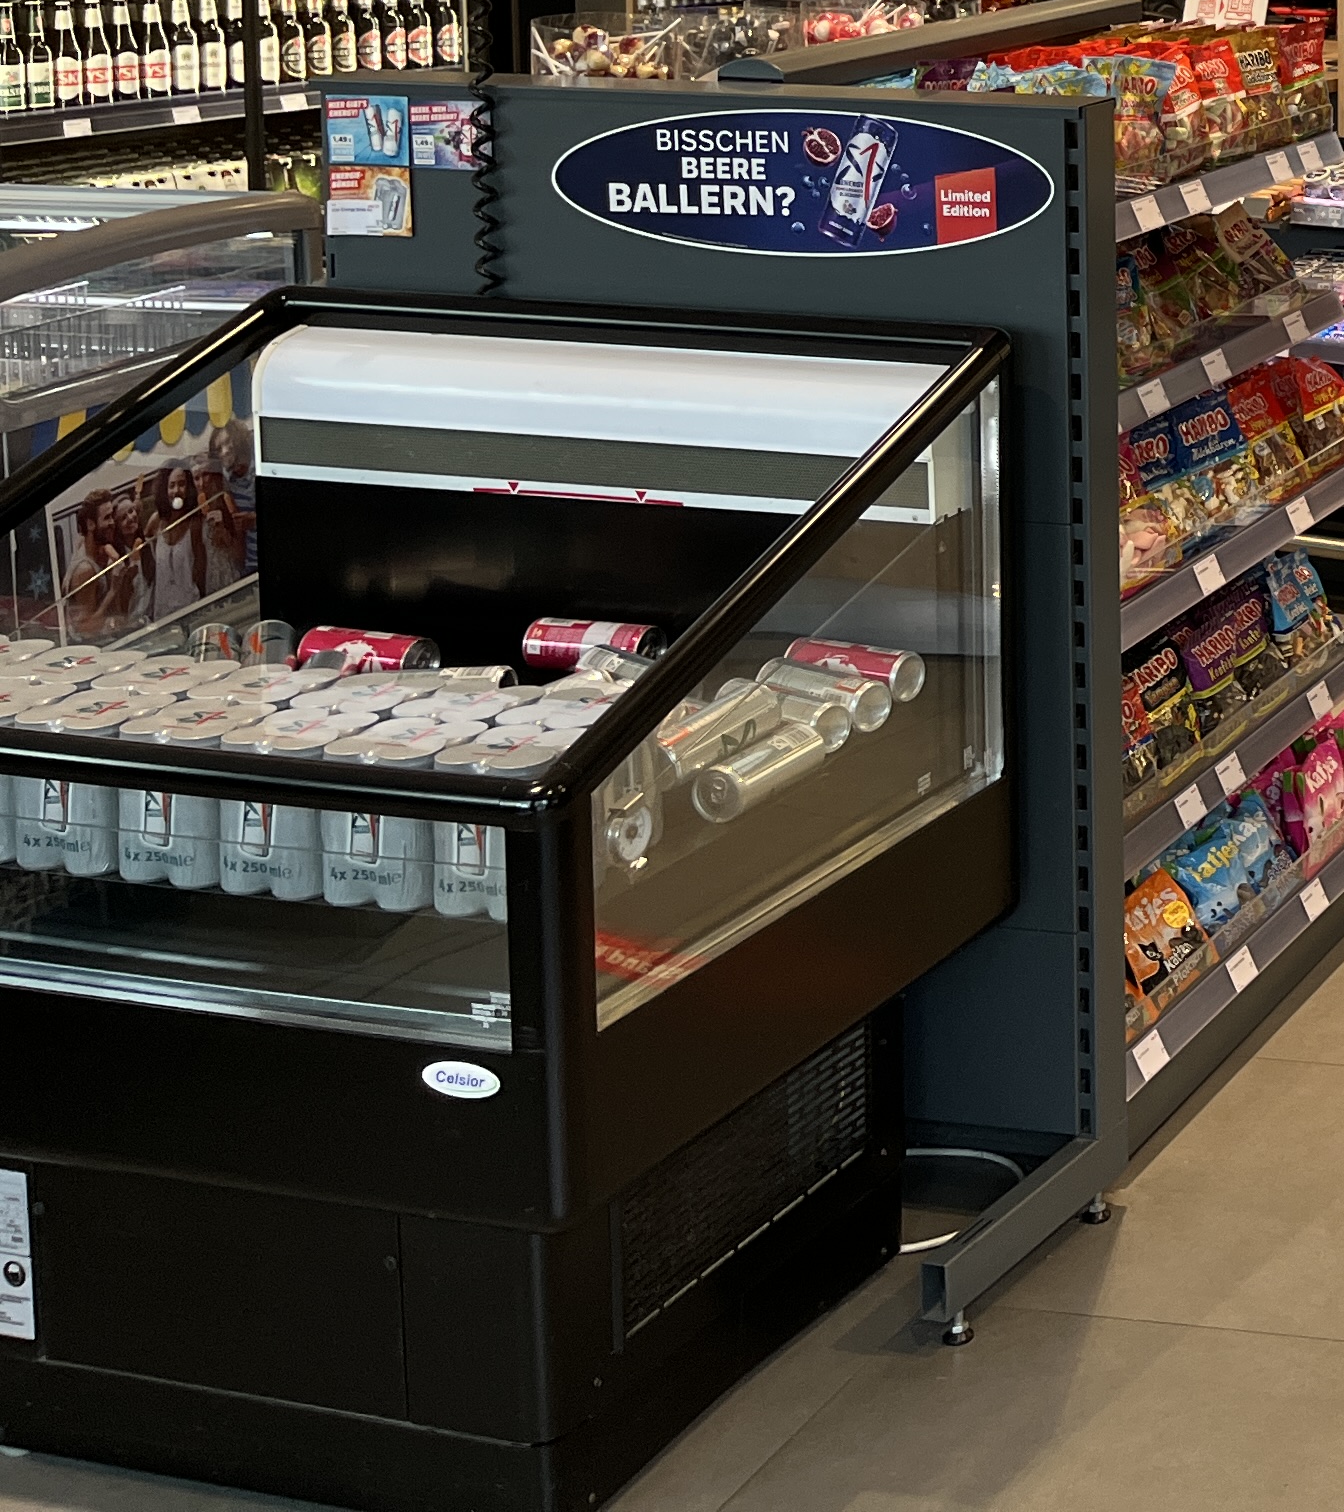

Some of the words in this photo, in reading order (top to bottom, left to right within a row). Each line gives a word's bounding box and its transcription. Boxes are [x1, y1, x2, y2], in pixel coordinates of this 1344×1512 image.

[1235, 48, 1275, 71] HARIBO
[655, 129, 789, 153] BISSCHEN
[681, 157, 767, 180] BEERE
[608, 182, 796, 216] BALLERN?
[940, 189, 991, 203] Limited
[942, 203, 990, 218] Edition
[435, 1069, 486, 1090] Celsior
